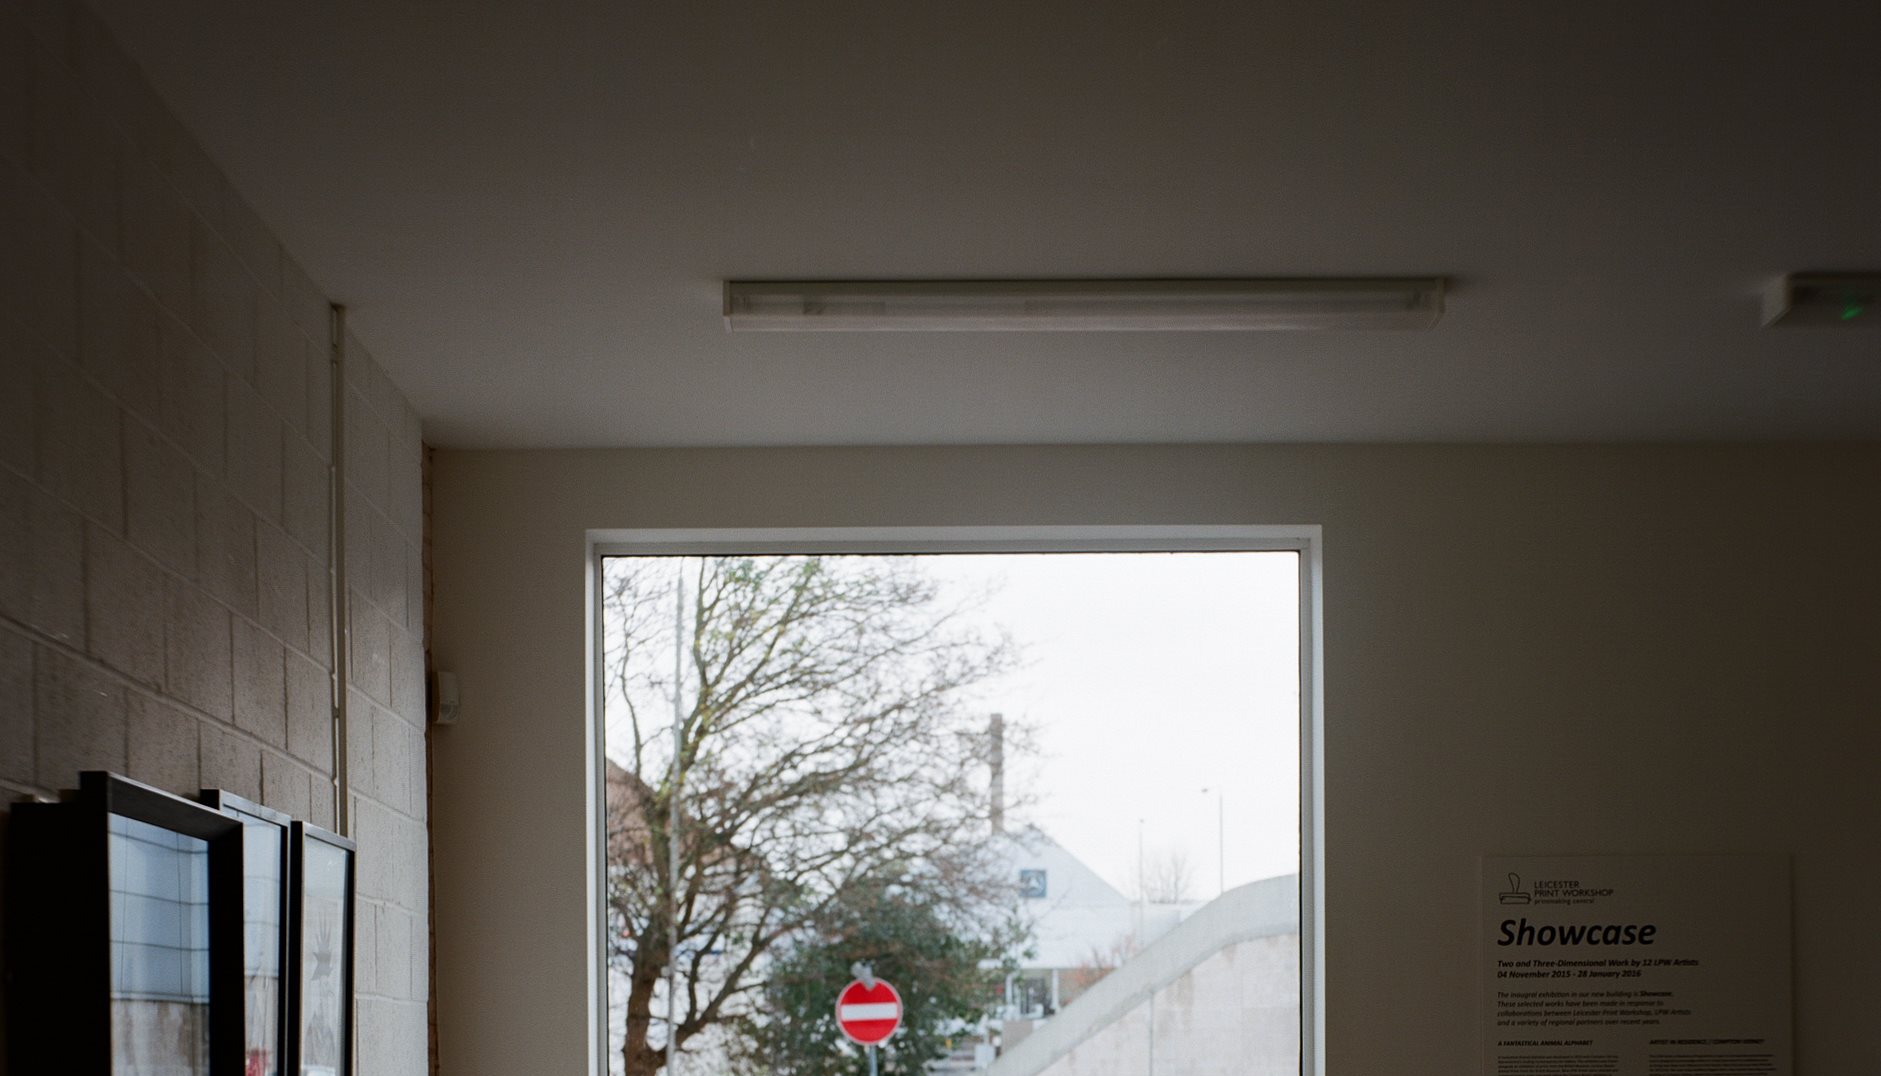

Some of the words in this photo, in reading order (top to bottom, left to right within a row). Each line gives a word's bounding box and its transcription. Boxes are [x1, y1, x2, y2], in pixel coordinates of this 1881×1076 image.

[1534, 889, 1559, 897] PRINT
[1562, 889, 1614, 897] WORKSHOP
[1497, 918, 1656, 946] Showcase
[1631, 960, 1641, 968] by
[1589, 970, 1620, 979] January
[1606, 990, 1632, 1000] building
[1540, 1018, 1547, 1026] of
